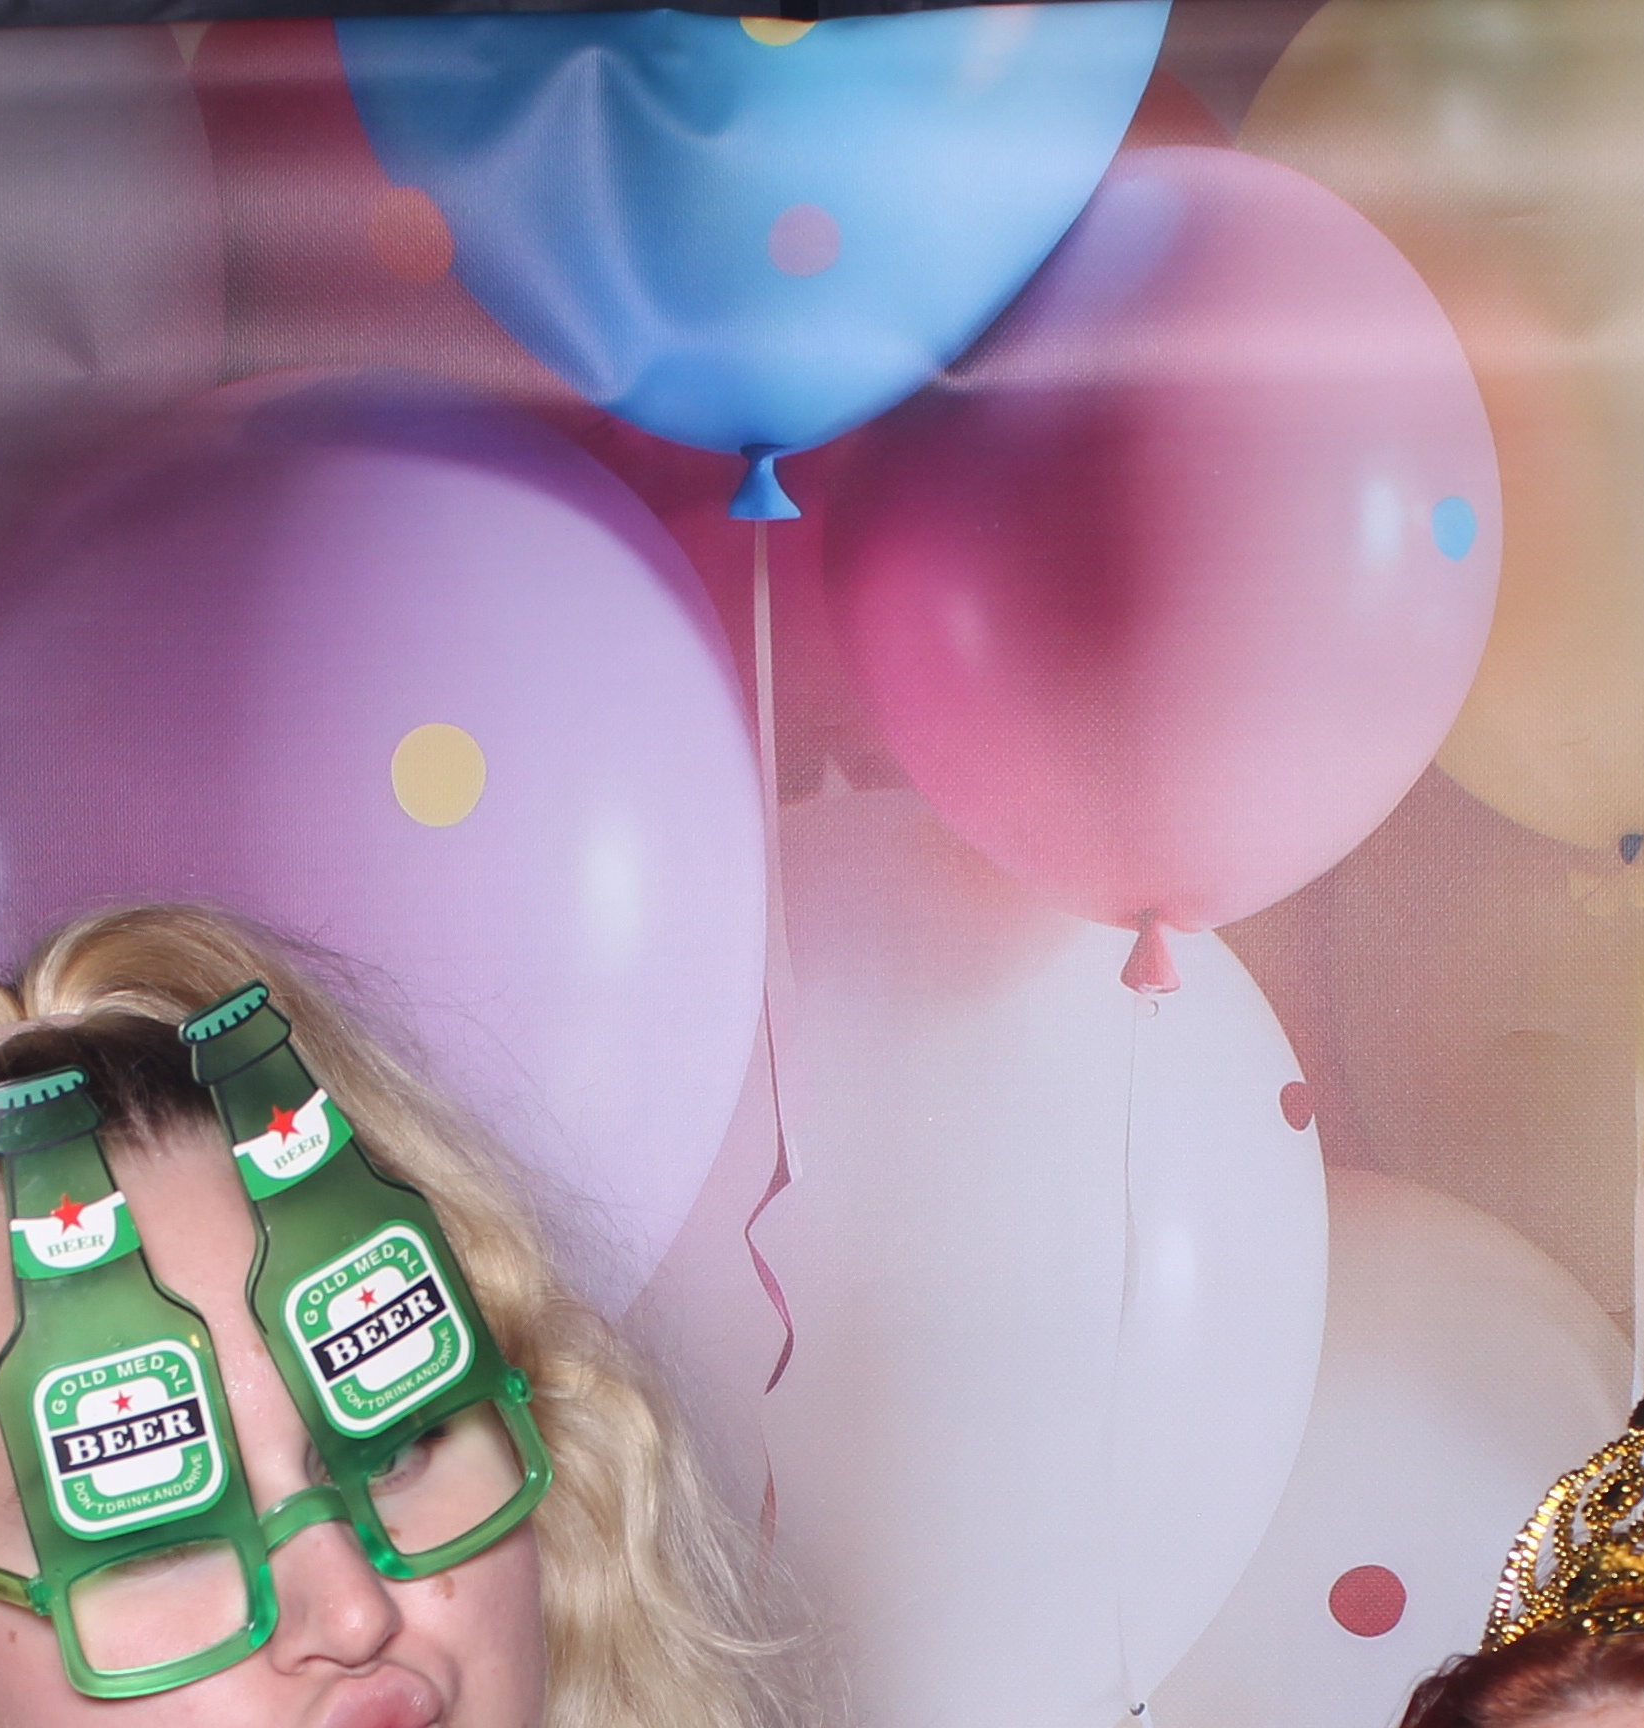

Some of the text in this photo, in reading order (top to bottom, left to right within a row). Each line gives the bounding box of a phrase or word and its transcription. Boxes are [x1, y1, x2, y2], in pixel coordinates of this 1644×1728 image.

[273, 1134, 323, 1170] BEER
[47, 1234, 105, 1258] BEER
[303, 1243, 420, 1325] GOLD MEDAL
[323, 1288, 437, 1371] BEER
[52, 1355, 188, 1415] GOLD MEDAL
[375, 1379, 415, 1408] DRINK
[415, 1364, 440, 1384] AND
[438, 1327, 453, 1367] DRIVE
[64, 1408, 197, 1466] BEER
[104, 1493, 152, 1514] DRINK
[153, 1483, 182, 1502] AND
[182, 1452, 203, 1491] DRIVE
